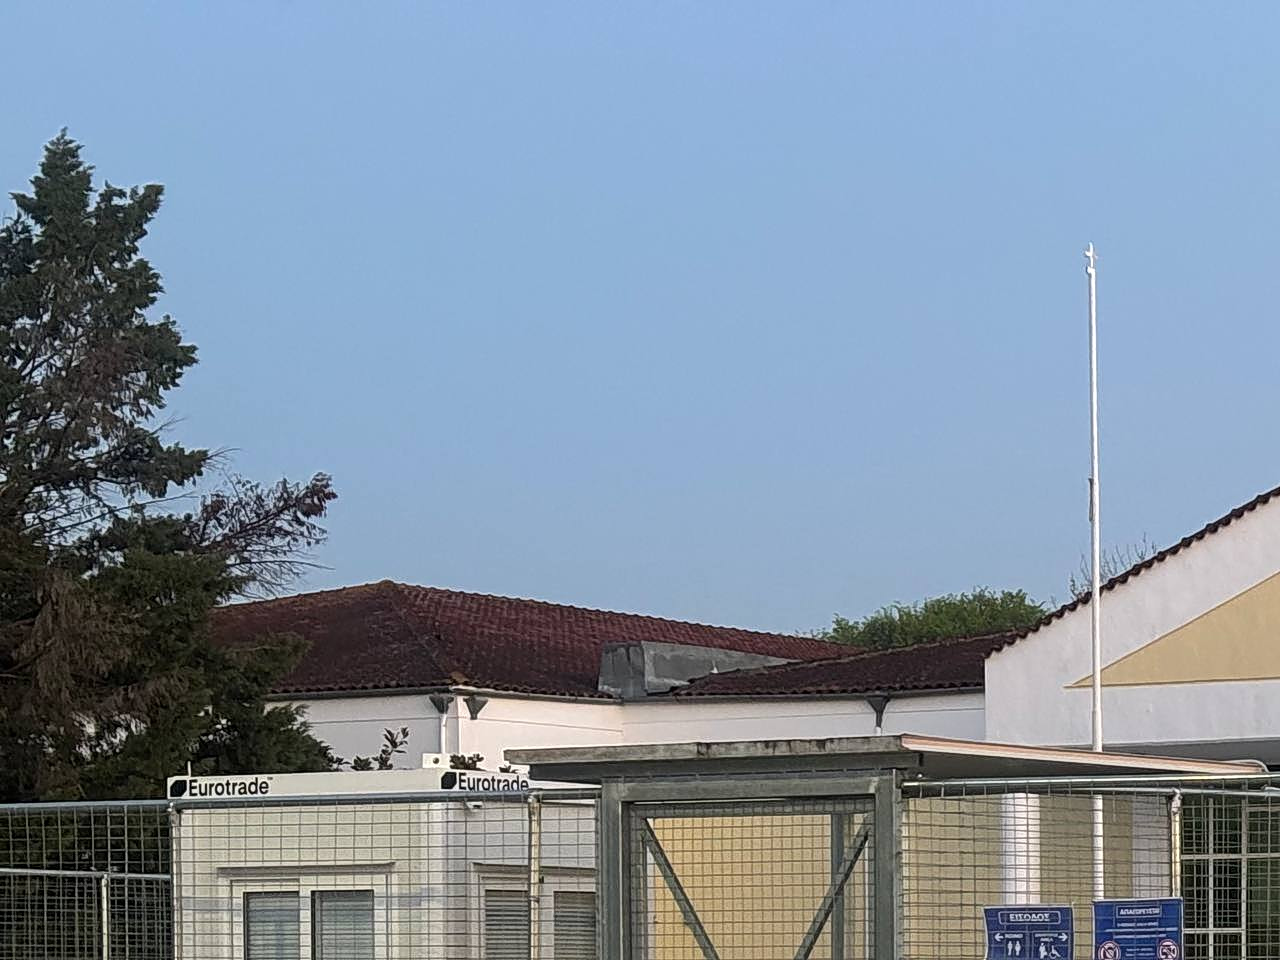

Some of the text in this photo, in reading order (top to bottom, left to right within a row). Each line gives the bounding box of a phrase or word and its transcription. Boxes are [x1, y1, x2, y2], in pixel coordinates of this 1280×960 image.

[189, 777, 269, 797] Eurotrade
[458, 772, 529, 792] Eurotrade
[1009, 913, 1050, 922] ΕΙΣΟΔΟΣ
